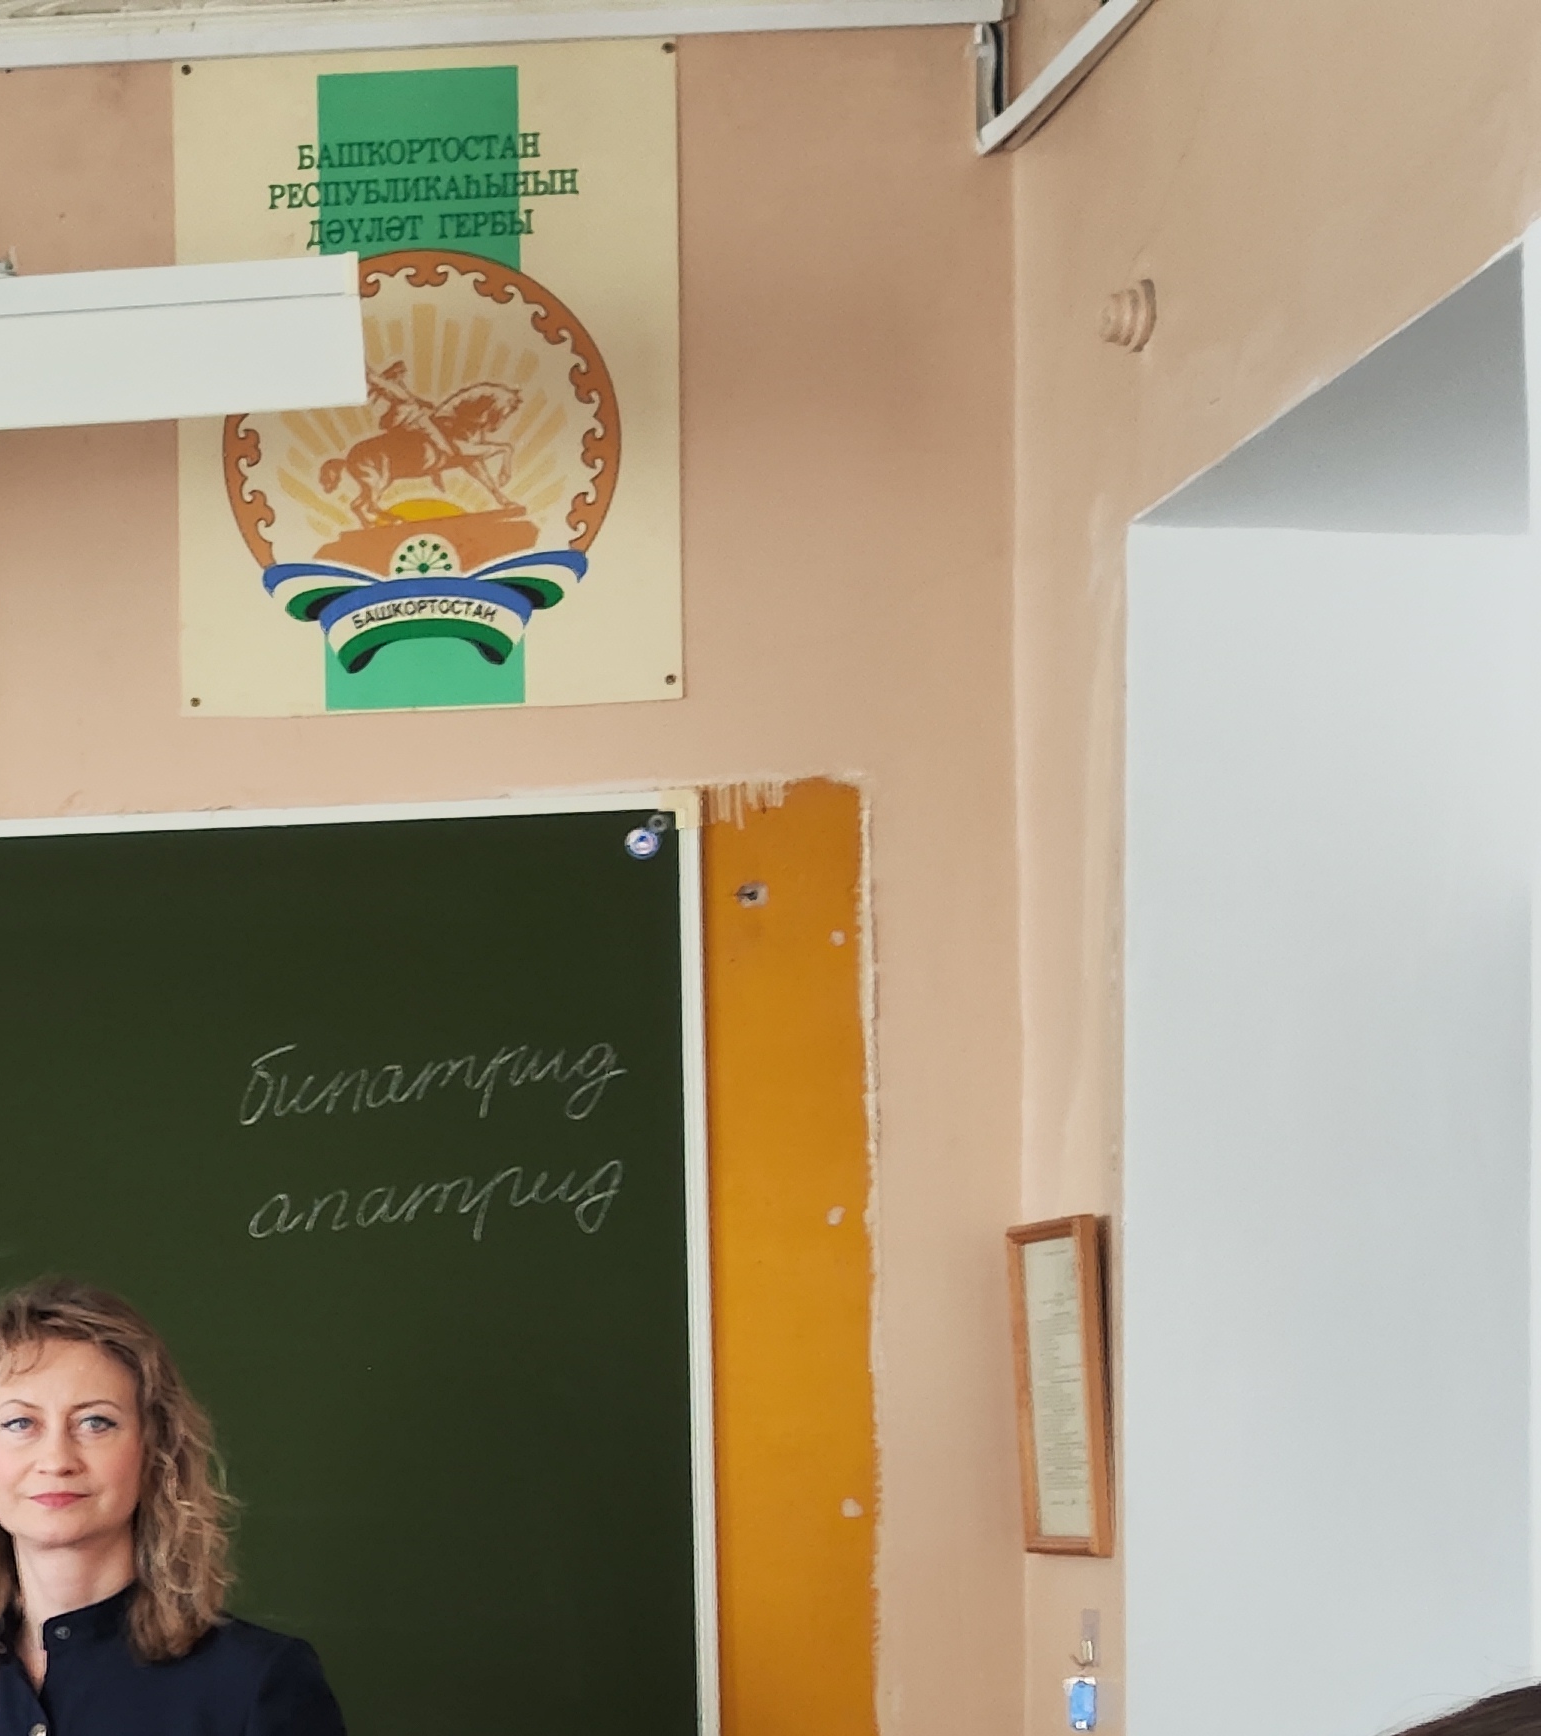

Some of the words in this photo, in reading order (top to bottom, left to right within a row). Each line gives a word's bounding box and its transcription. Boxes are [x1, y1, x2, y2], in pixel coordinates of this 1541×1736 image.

[307, 214, 423, 250] ДӘҮЛӘТ
[439, 209, 534, 240] ГЕРБЫ
[239, 1043, 628, 1126] бипатрид
[247, 1160, 623, 1241] апатрид
